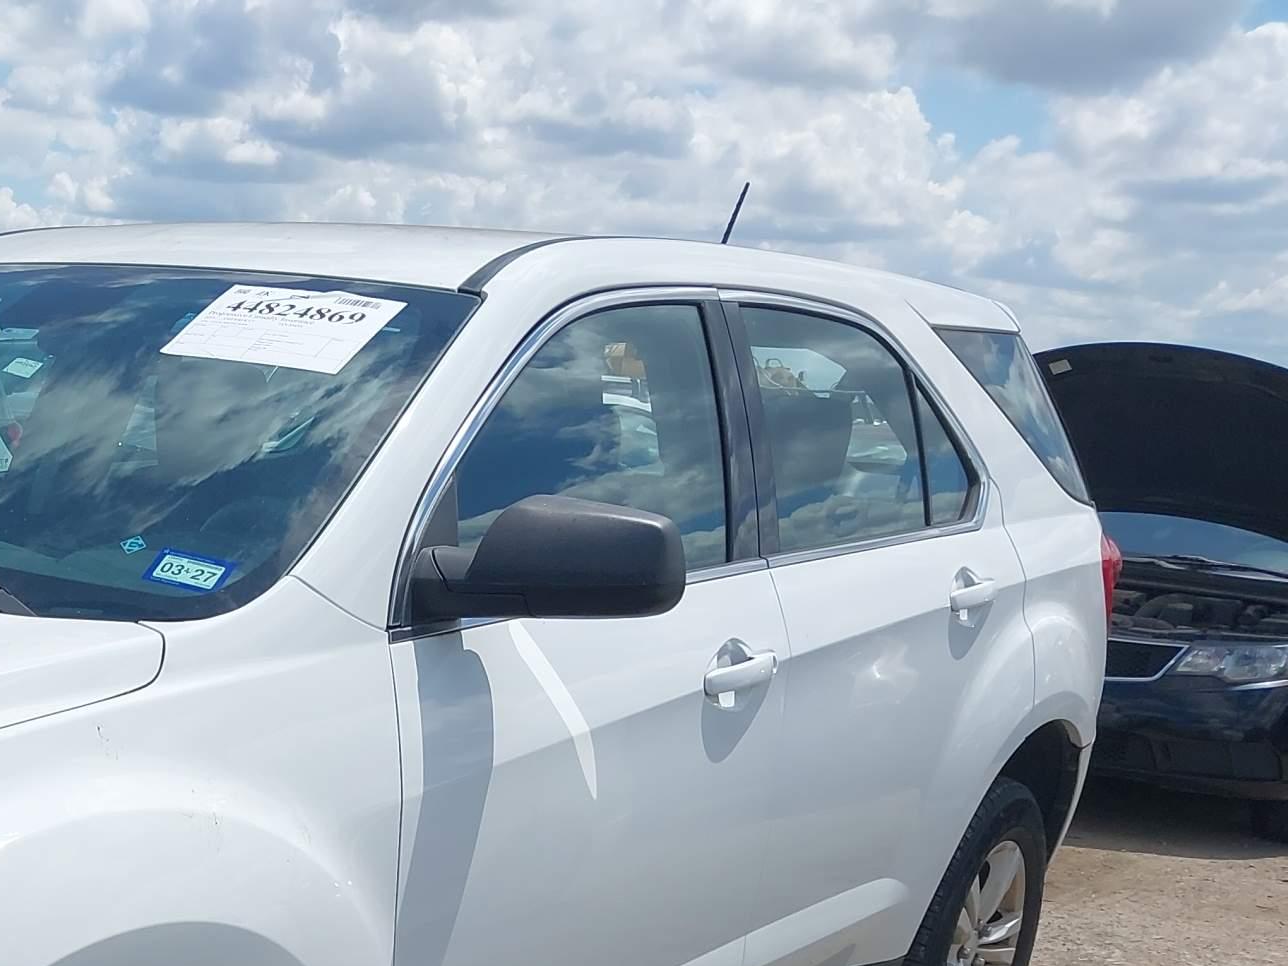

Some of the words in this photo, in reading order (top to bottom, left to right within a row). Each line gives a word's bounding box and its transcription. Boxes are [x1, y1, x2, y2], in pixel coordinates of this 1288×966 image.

[226, 300, 367, 325] 44824869
[159, 561, 185, 576] 03
[190, 568, 217, 583] 27
